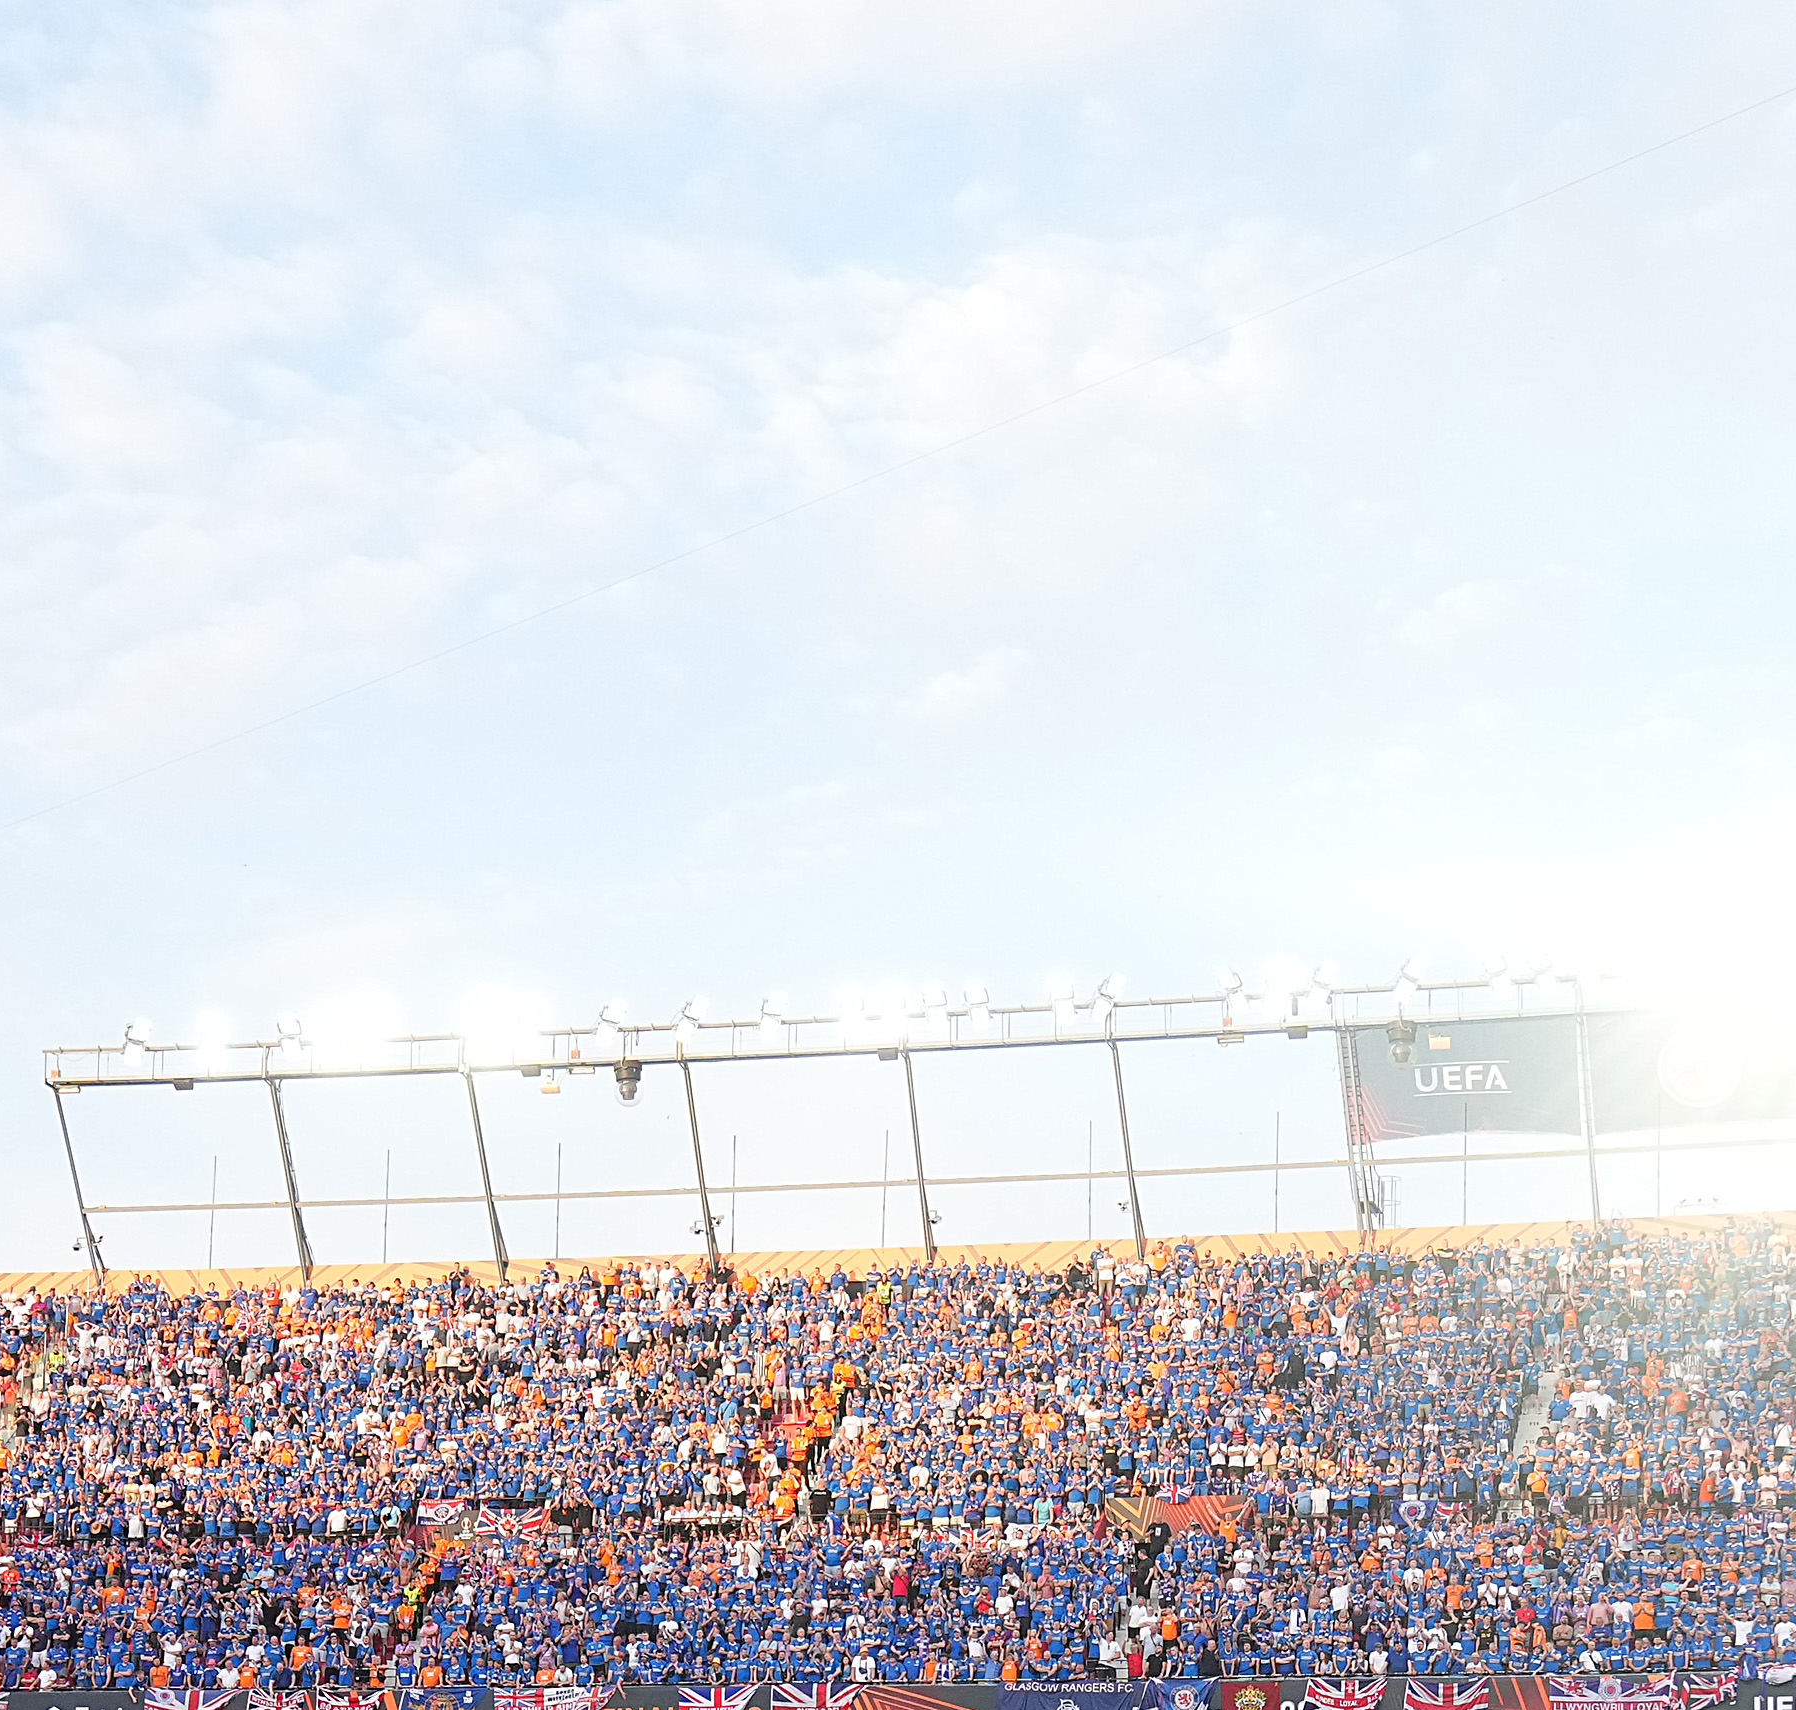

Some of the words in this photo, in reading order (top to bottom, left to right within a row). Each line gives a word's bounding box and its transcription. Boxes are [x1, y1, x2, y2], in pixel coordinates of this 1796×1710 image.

[1414, 1065, 1508, 1092] UEFA
[1004, 1681, 1058, 1692] GLASGOW
[1061, 1682, 1115, 1693] RANGERS
